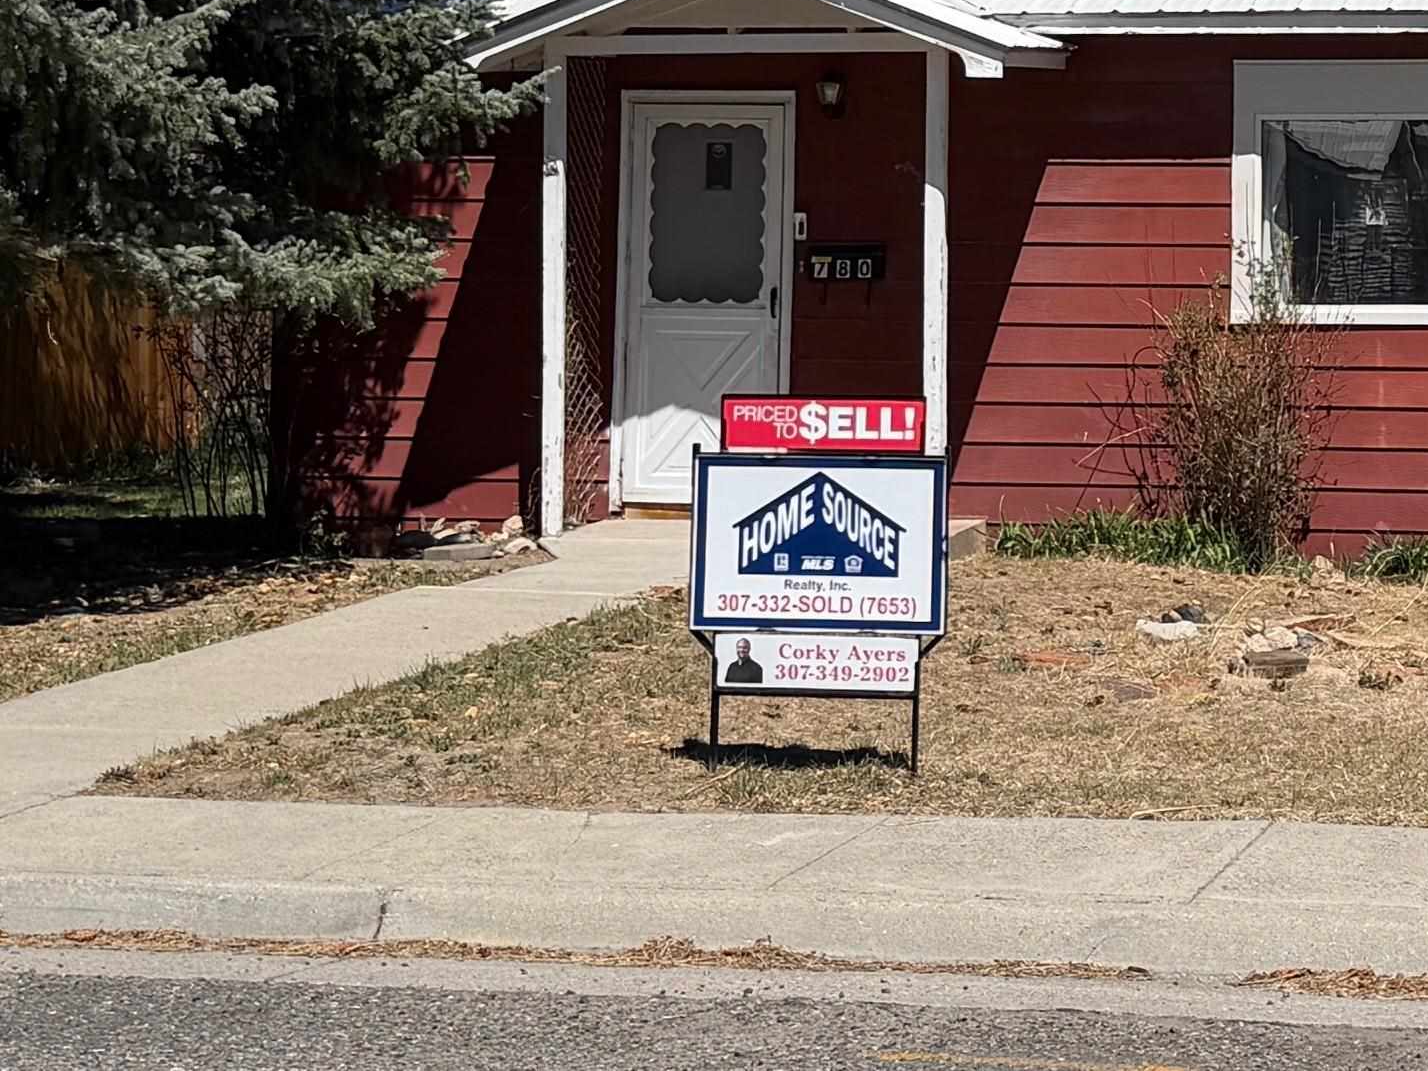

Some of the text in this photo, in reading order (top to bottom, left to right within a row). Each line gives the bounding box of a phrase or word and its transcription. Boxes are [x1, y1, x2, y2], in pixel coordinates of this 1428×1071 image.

[815, 259, 871, 277] 780
[733, 405, 798, 422] PRICED
[774, 401, 915, 444] TO $ELL!
[741, 482, 896, 571] HOME SOURCE
[801, 559, 834, 570] MLS
[784, 579, 852, 592] Realty, Inc.
[718, 594, 917, 619] 307-332-SOLD (7653)
[778, 643, 906, 665] Corky Ayers
[775, 664, 909, 682] 307-349-2902
